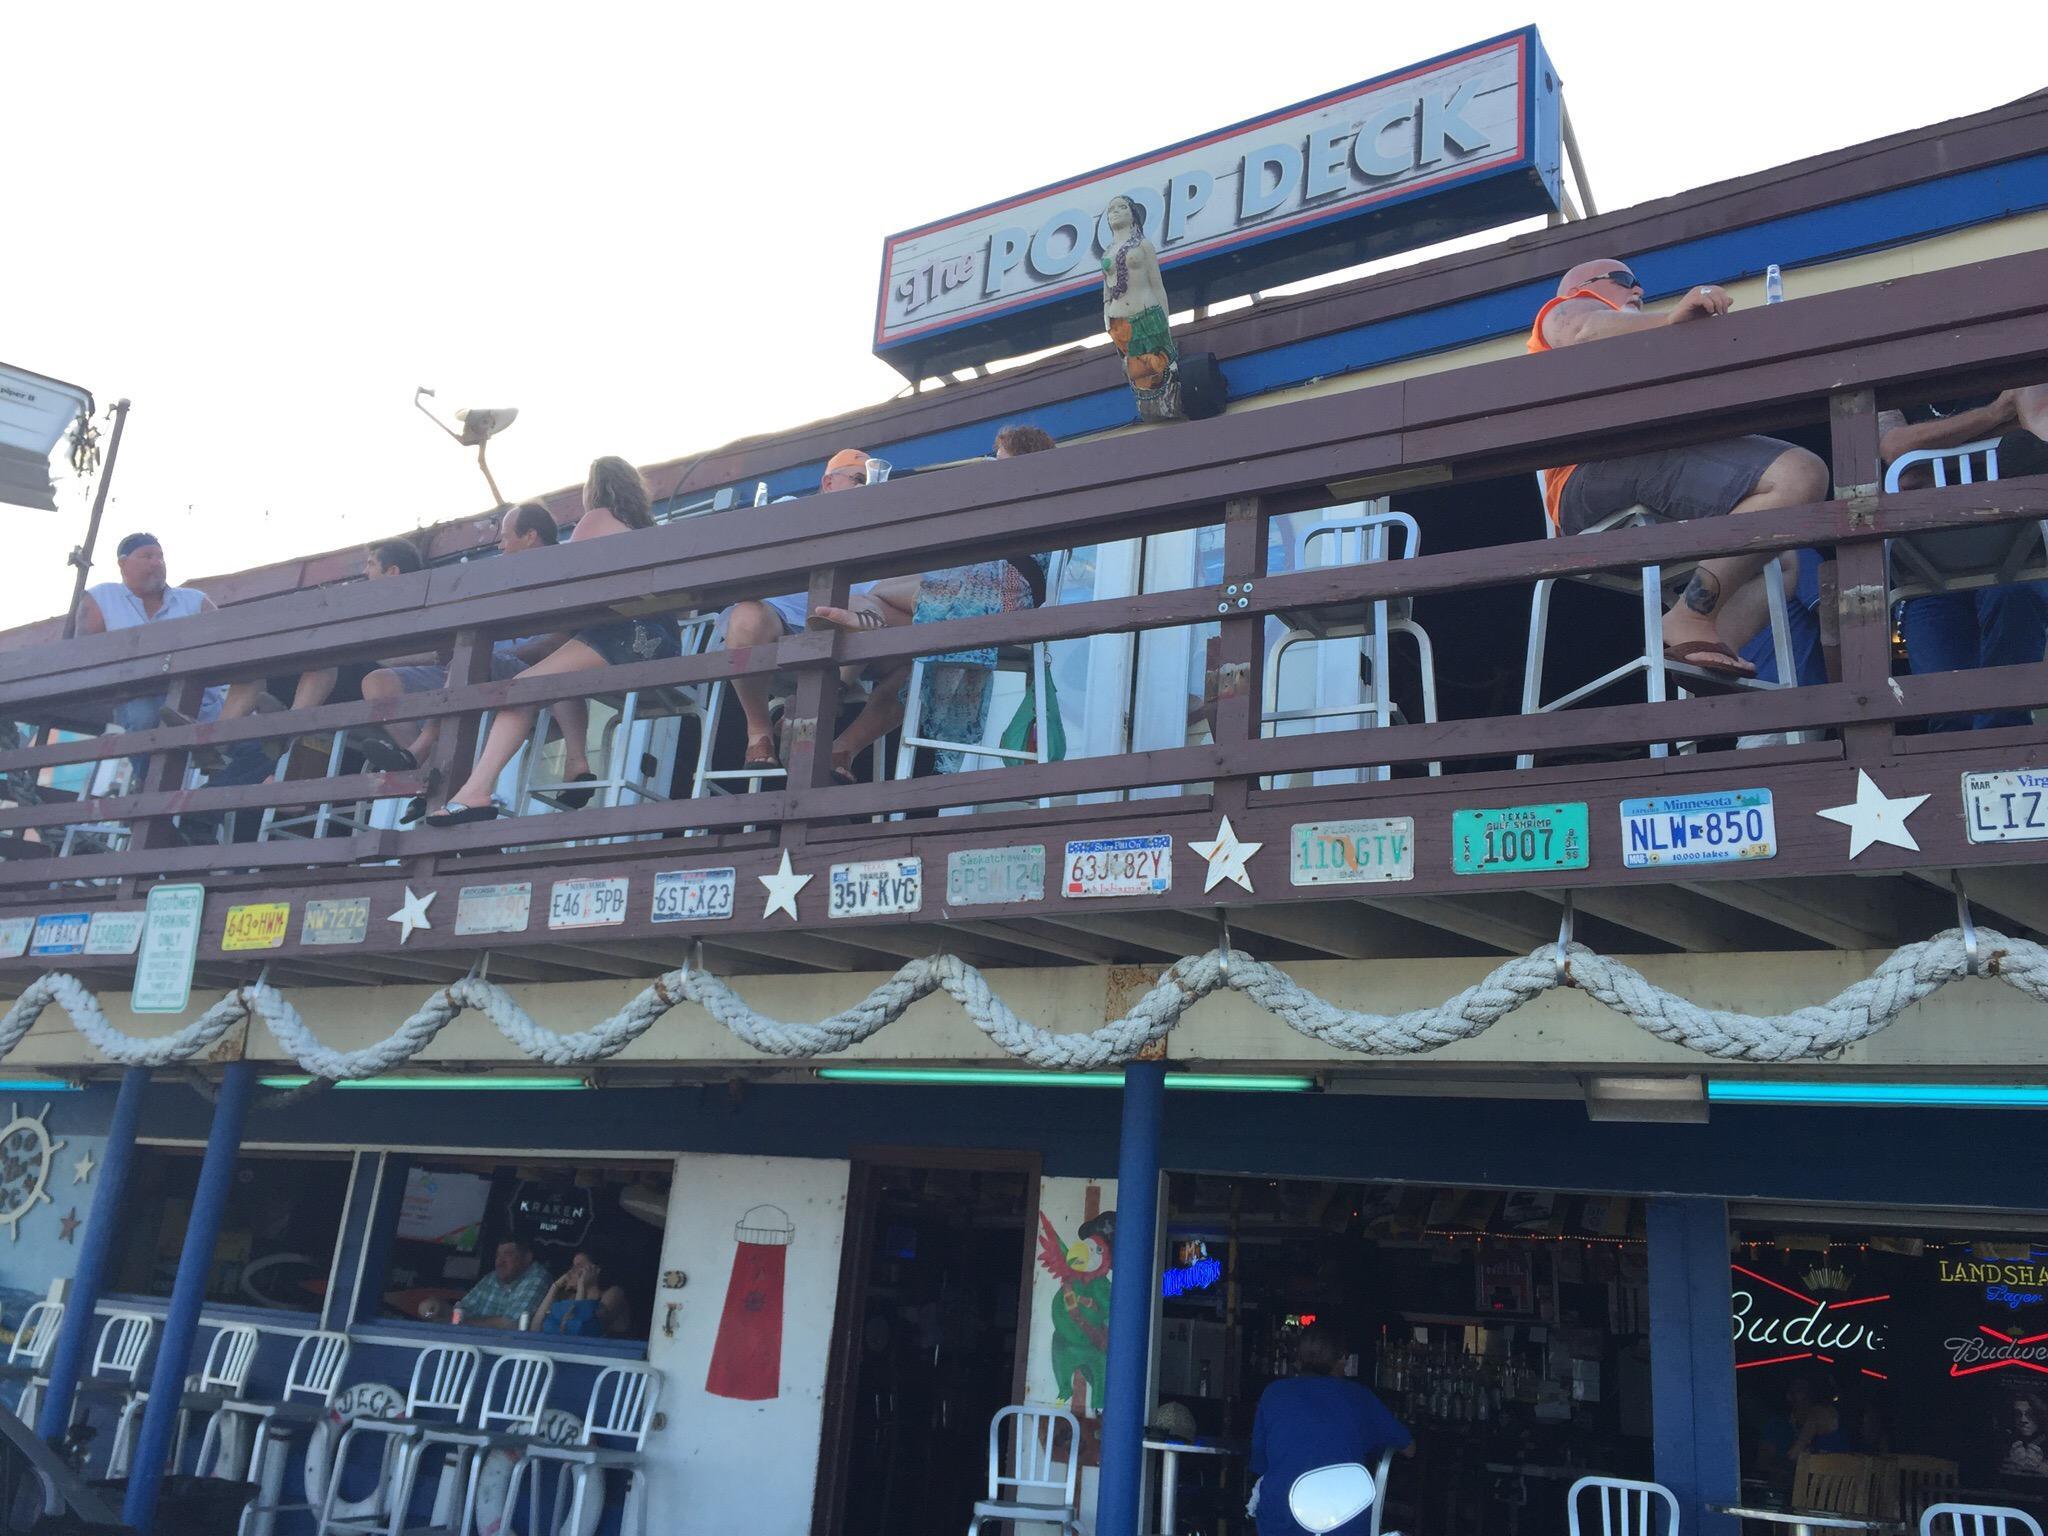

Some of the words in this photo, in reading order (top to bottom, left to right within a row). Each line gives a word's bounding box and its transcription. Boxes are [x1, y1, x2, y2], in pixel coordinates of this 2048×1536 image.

[896, 250, 976, 314] The
[984, 169, 1214, 295] POOP
[1237, 78, 1491, 221] DECK
[1971, 781, 1991, 790] MAR
[1502, 812, 1536, 822] TEXAS
[1664, 797, 1732, 811] Minnesota
[1975, 791, 2046, 831] LIZ
[1487, 821, 1510, 831] GULF
[1514, 819, 1552, 829] SHRIMP
[1630, 815, 1687, 851] NLW
[1706, 808, 1763, 846] 850
[960, 852, 1035, 866] Saskatchewan
[1356, 834, 1405, 866] GTV
[1484, 828, 1554, 864] 1007
[1006, 862, 1041, 890] 124
[1072, 852, 1110, 882] 63J
[1124, 849, 1162, 879] 82Y
[552, 892, 580, 918] E46
[595, 888, 624, 915] 5PB
[657, 886, 690, 912] 6ST
[696, 884, 730, 910] X23
[834, 880, 869, 910] 35V
[878, 877, 915, 906] KVG
[227, 913, 253, 937] 643
[328, 907, 366, 929] 7272
[520, 1200, 584, 1219] KRAKEN
[1939, 1260, 2048, 1287] LANDSHA
